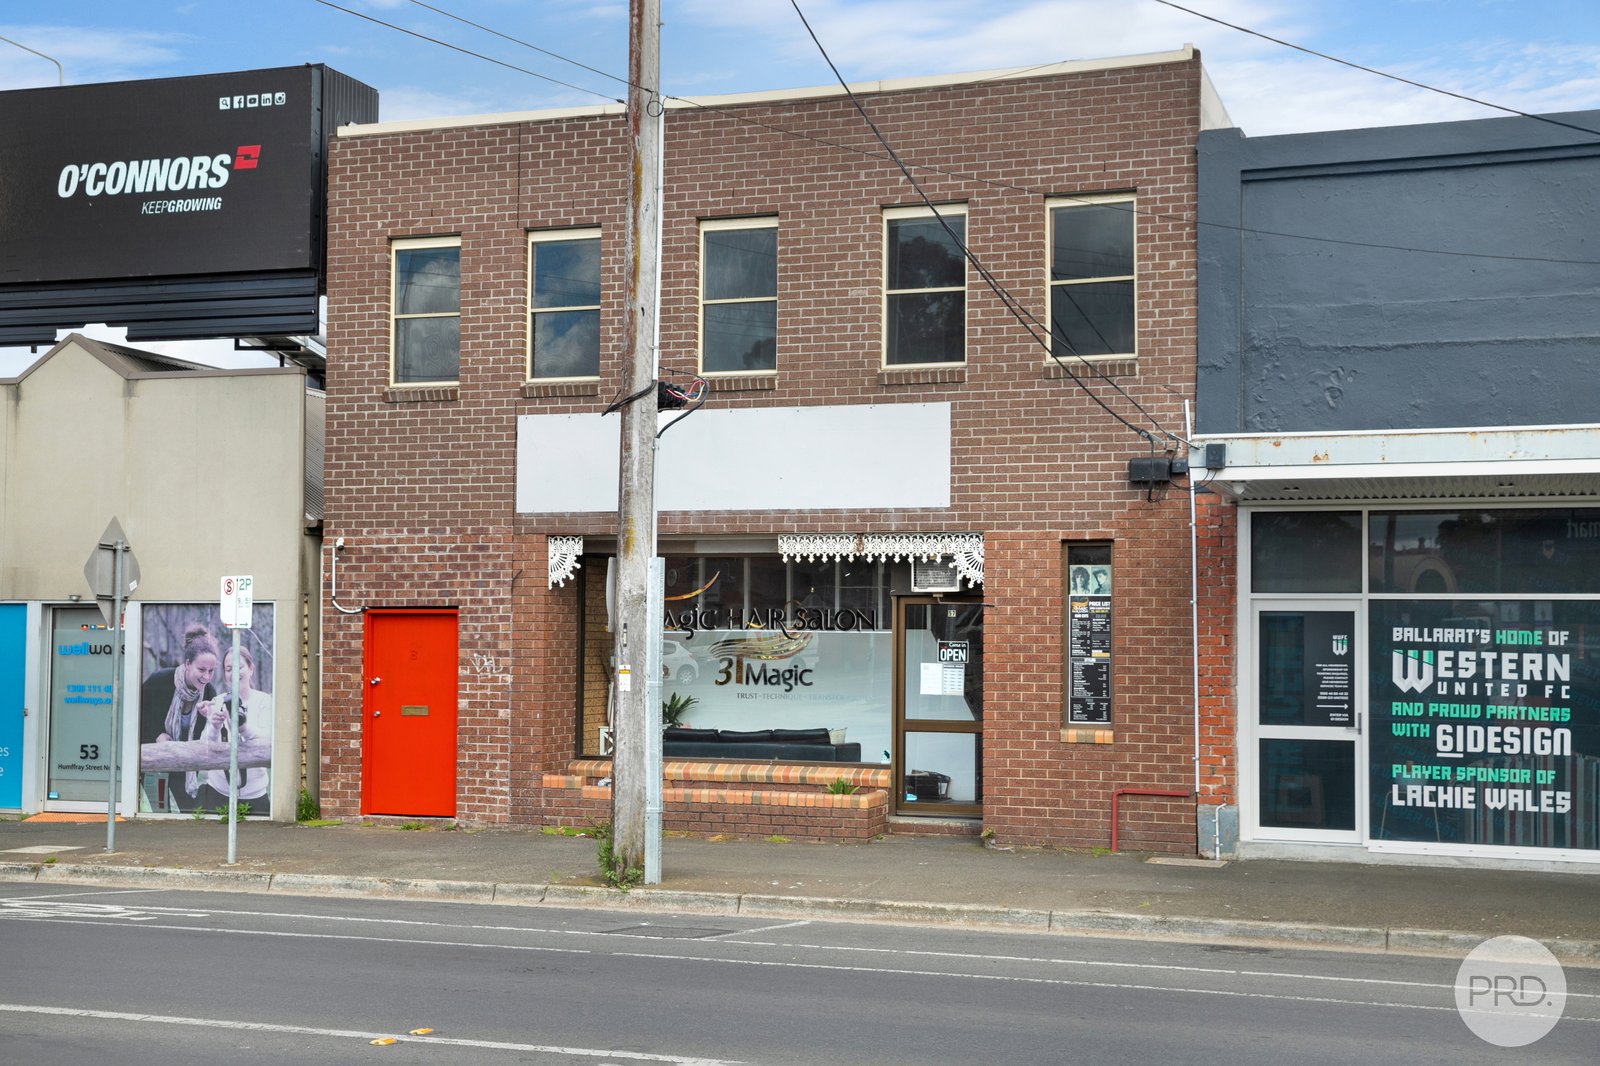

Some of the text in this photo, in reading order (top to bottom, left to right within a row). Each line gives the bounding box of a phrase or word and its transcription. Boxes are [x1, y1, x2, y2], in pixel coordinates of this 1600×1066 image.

[57, 153, 232, 198] O'CONNORS
[239, 578, 252, 590] 2P
[1393, 627, 1570, 646] BALLARAT'S HOME OF
[58, 641, 125, 656] wellwas
[940, 648, 966, 661] OPEN
[1392, 650, 1570, 694] WESTERN
[1437, 682, 1570, 699] UNITED FC
[1392, 702, 1571, 721] AND PROUD PARTNERS
[1392, 723, 1430, 737] WITH
[80, 745, 99, 760] 53
[1392, 764, 1556, 784] PLAYER SPONSOR OF
[1392, 784, 1571, 813] LACHIE WALES
